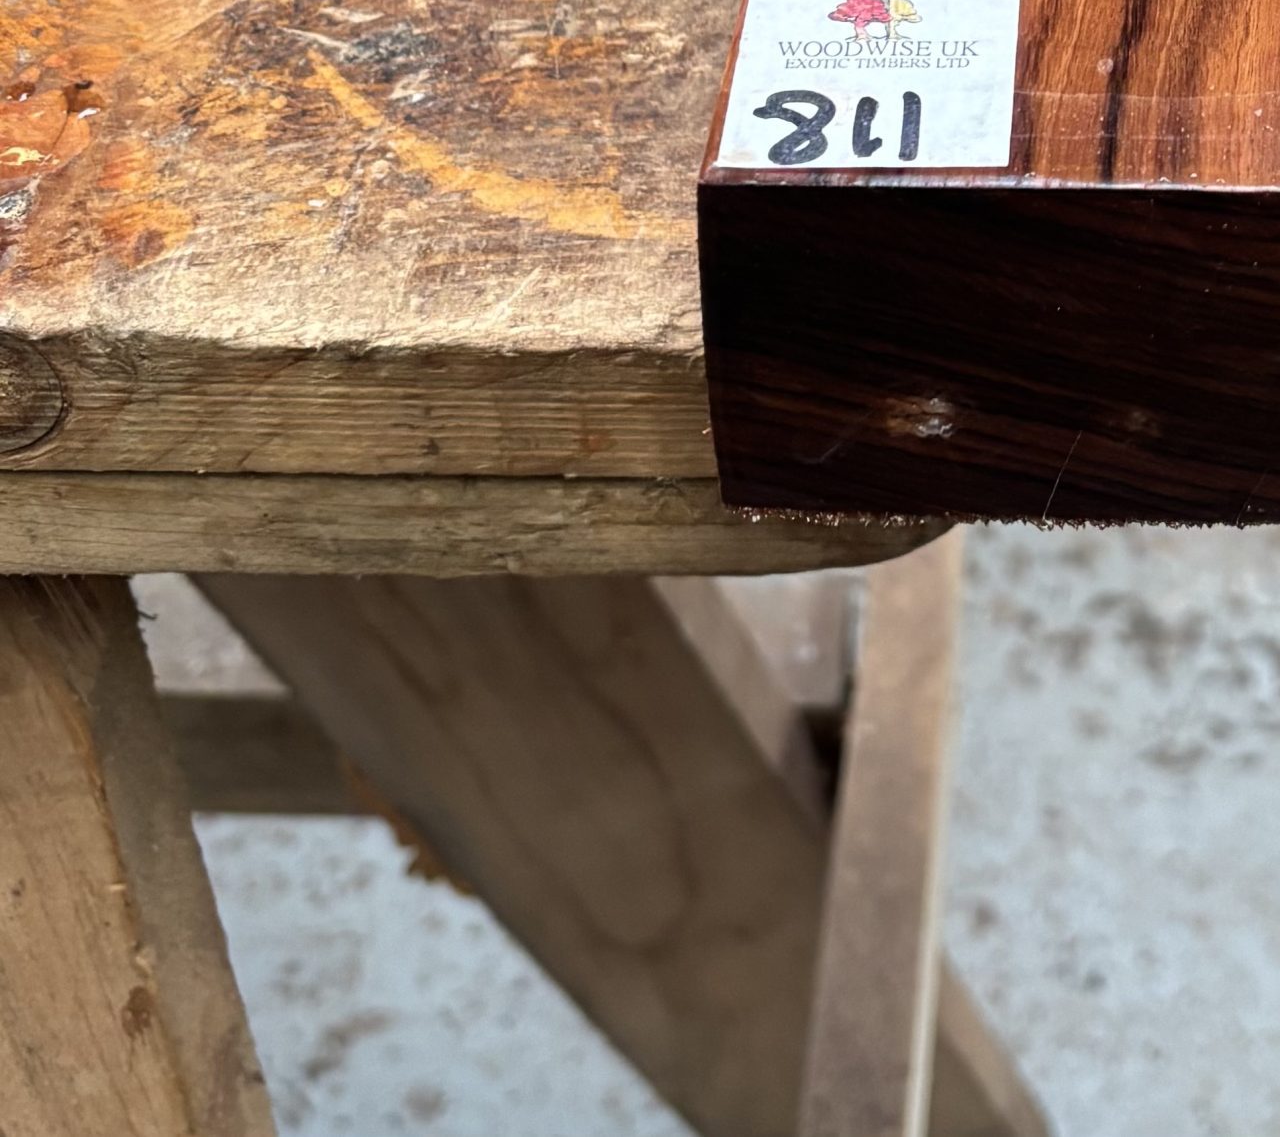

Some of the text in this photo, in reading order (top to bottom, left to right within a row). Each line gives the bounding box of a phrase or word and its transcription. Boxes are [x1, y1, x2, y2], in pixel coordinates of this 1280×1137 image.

[778, 40, 979, 57] WOODWISE UK
[785, 57, 970, 69] EXOTIC TIMBERS LTD
